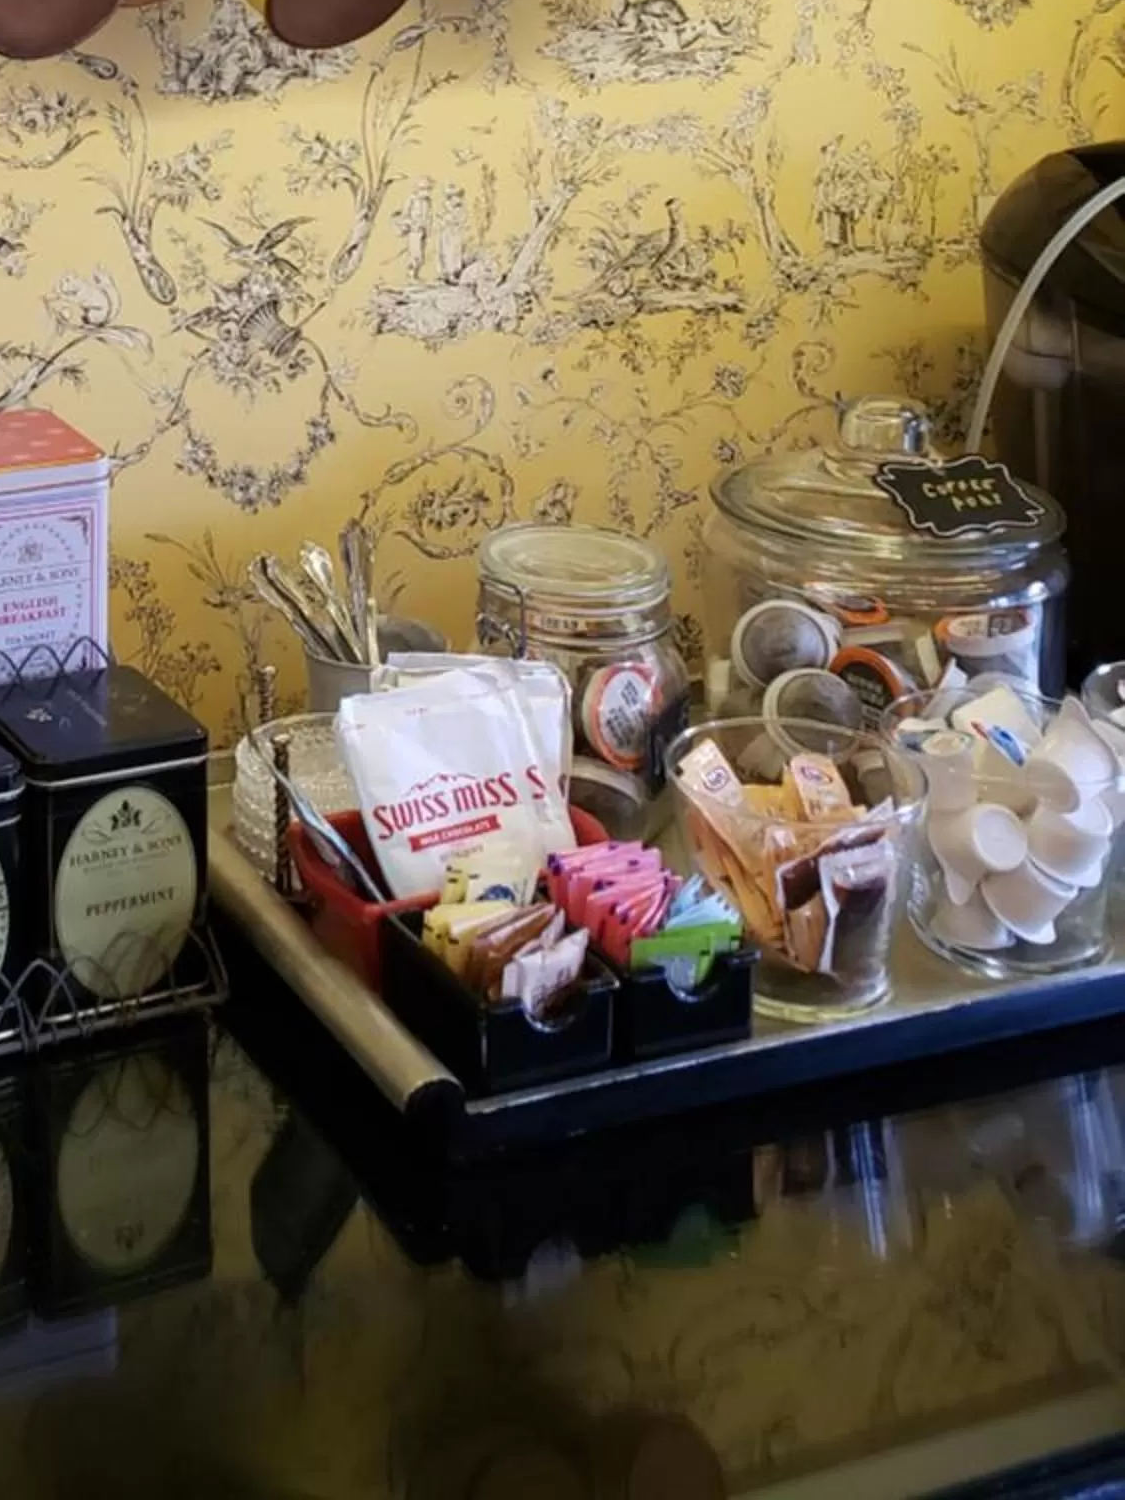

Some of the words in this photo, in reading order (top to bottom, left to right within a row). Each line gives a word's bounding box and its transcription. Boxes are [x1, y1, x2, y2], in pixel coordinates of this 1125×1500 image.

[34, 572, 47, 584] &
[48, 565, 82, 581] SONS
[2, 596, 59, 613] ENGLISH
[69, 847, 128, 868] HARNEY
[132, 843, 143, 853] &
[85, 887, 175, 917] PEPPERMINT
